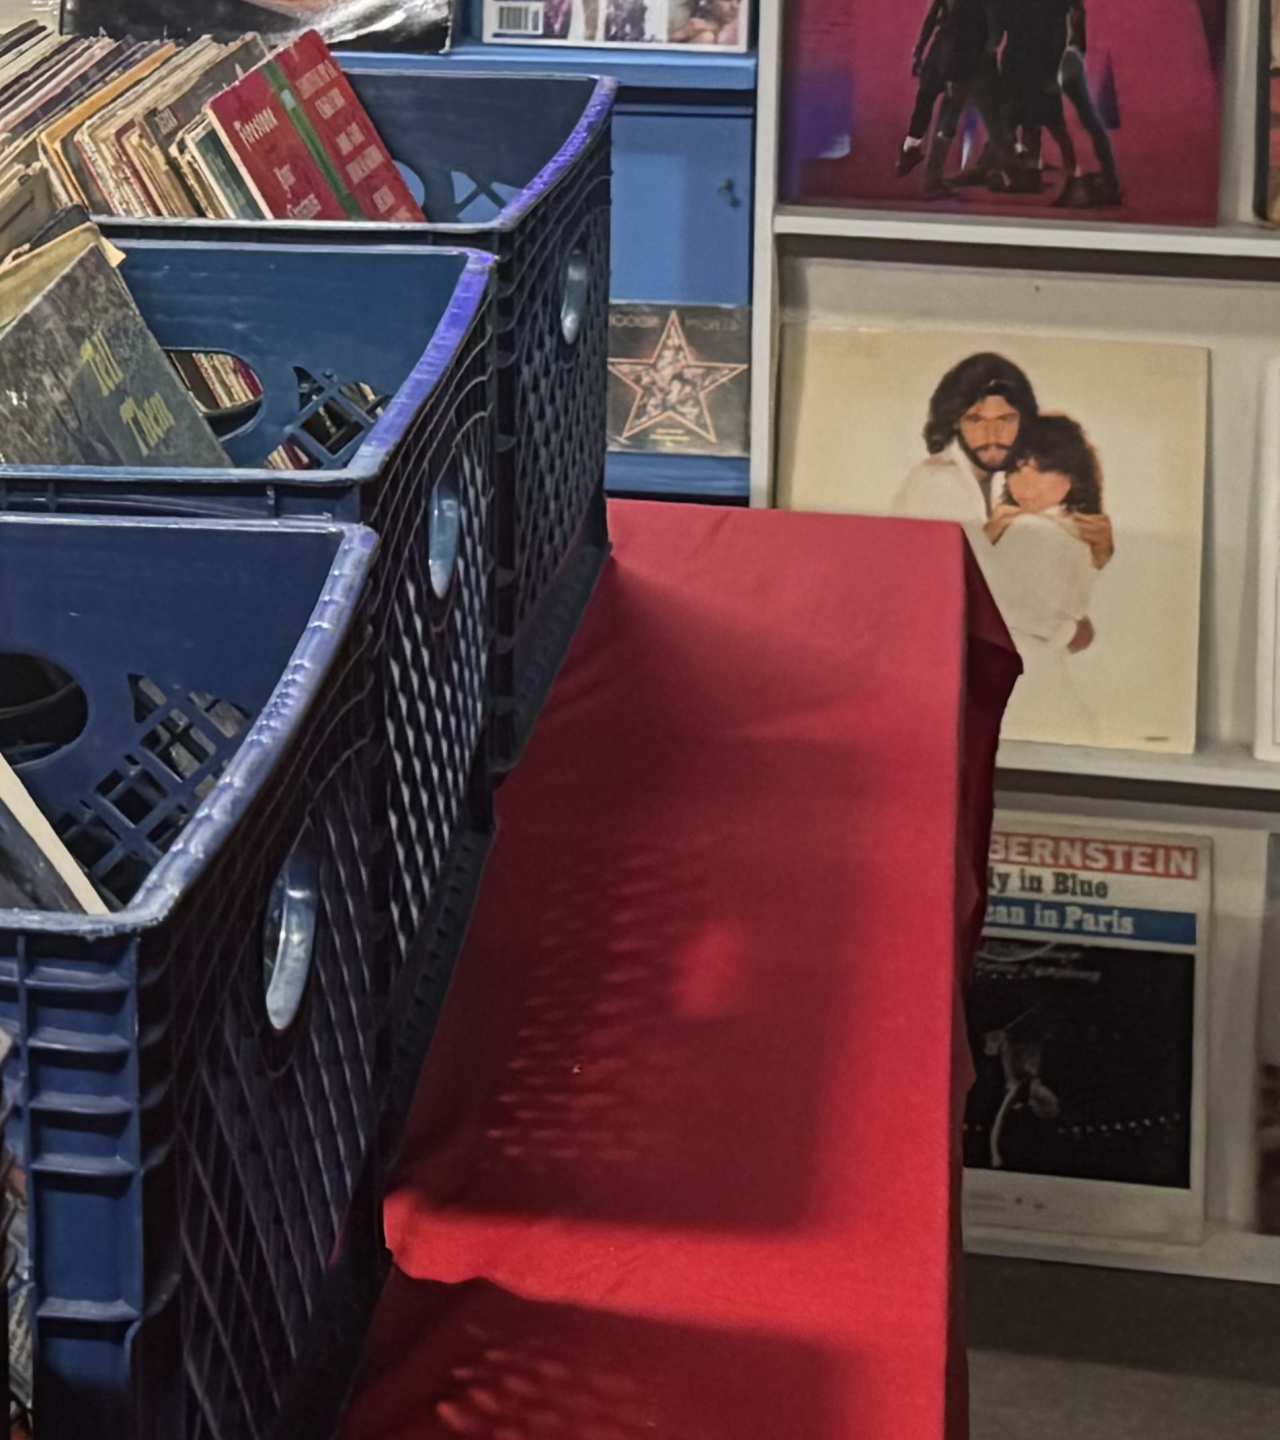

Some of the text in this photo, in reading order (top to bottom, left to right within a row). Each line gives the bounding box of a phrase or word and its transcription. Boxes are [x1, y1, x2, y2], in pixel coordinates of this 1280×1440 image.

[989, 835, 1197, 877] BERNSTEIN
[1020, 868, 1042, 893] in
[1053, 872, 1108, 898] Blue
[1033, 902, 1060, 928] in
[1065, 906, 1135, 934] Paris
